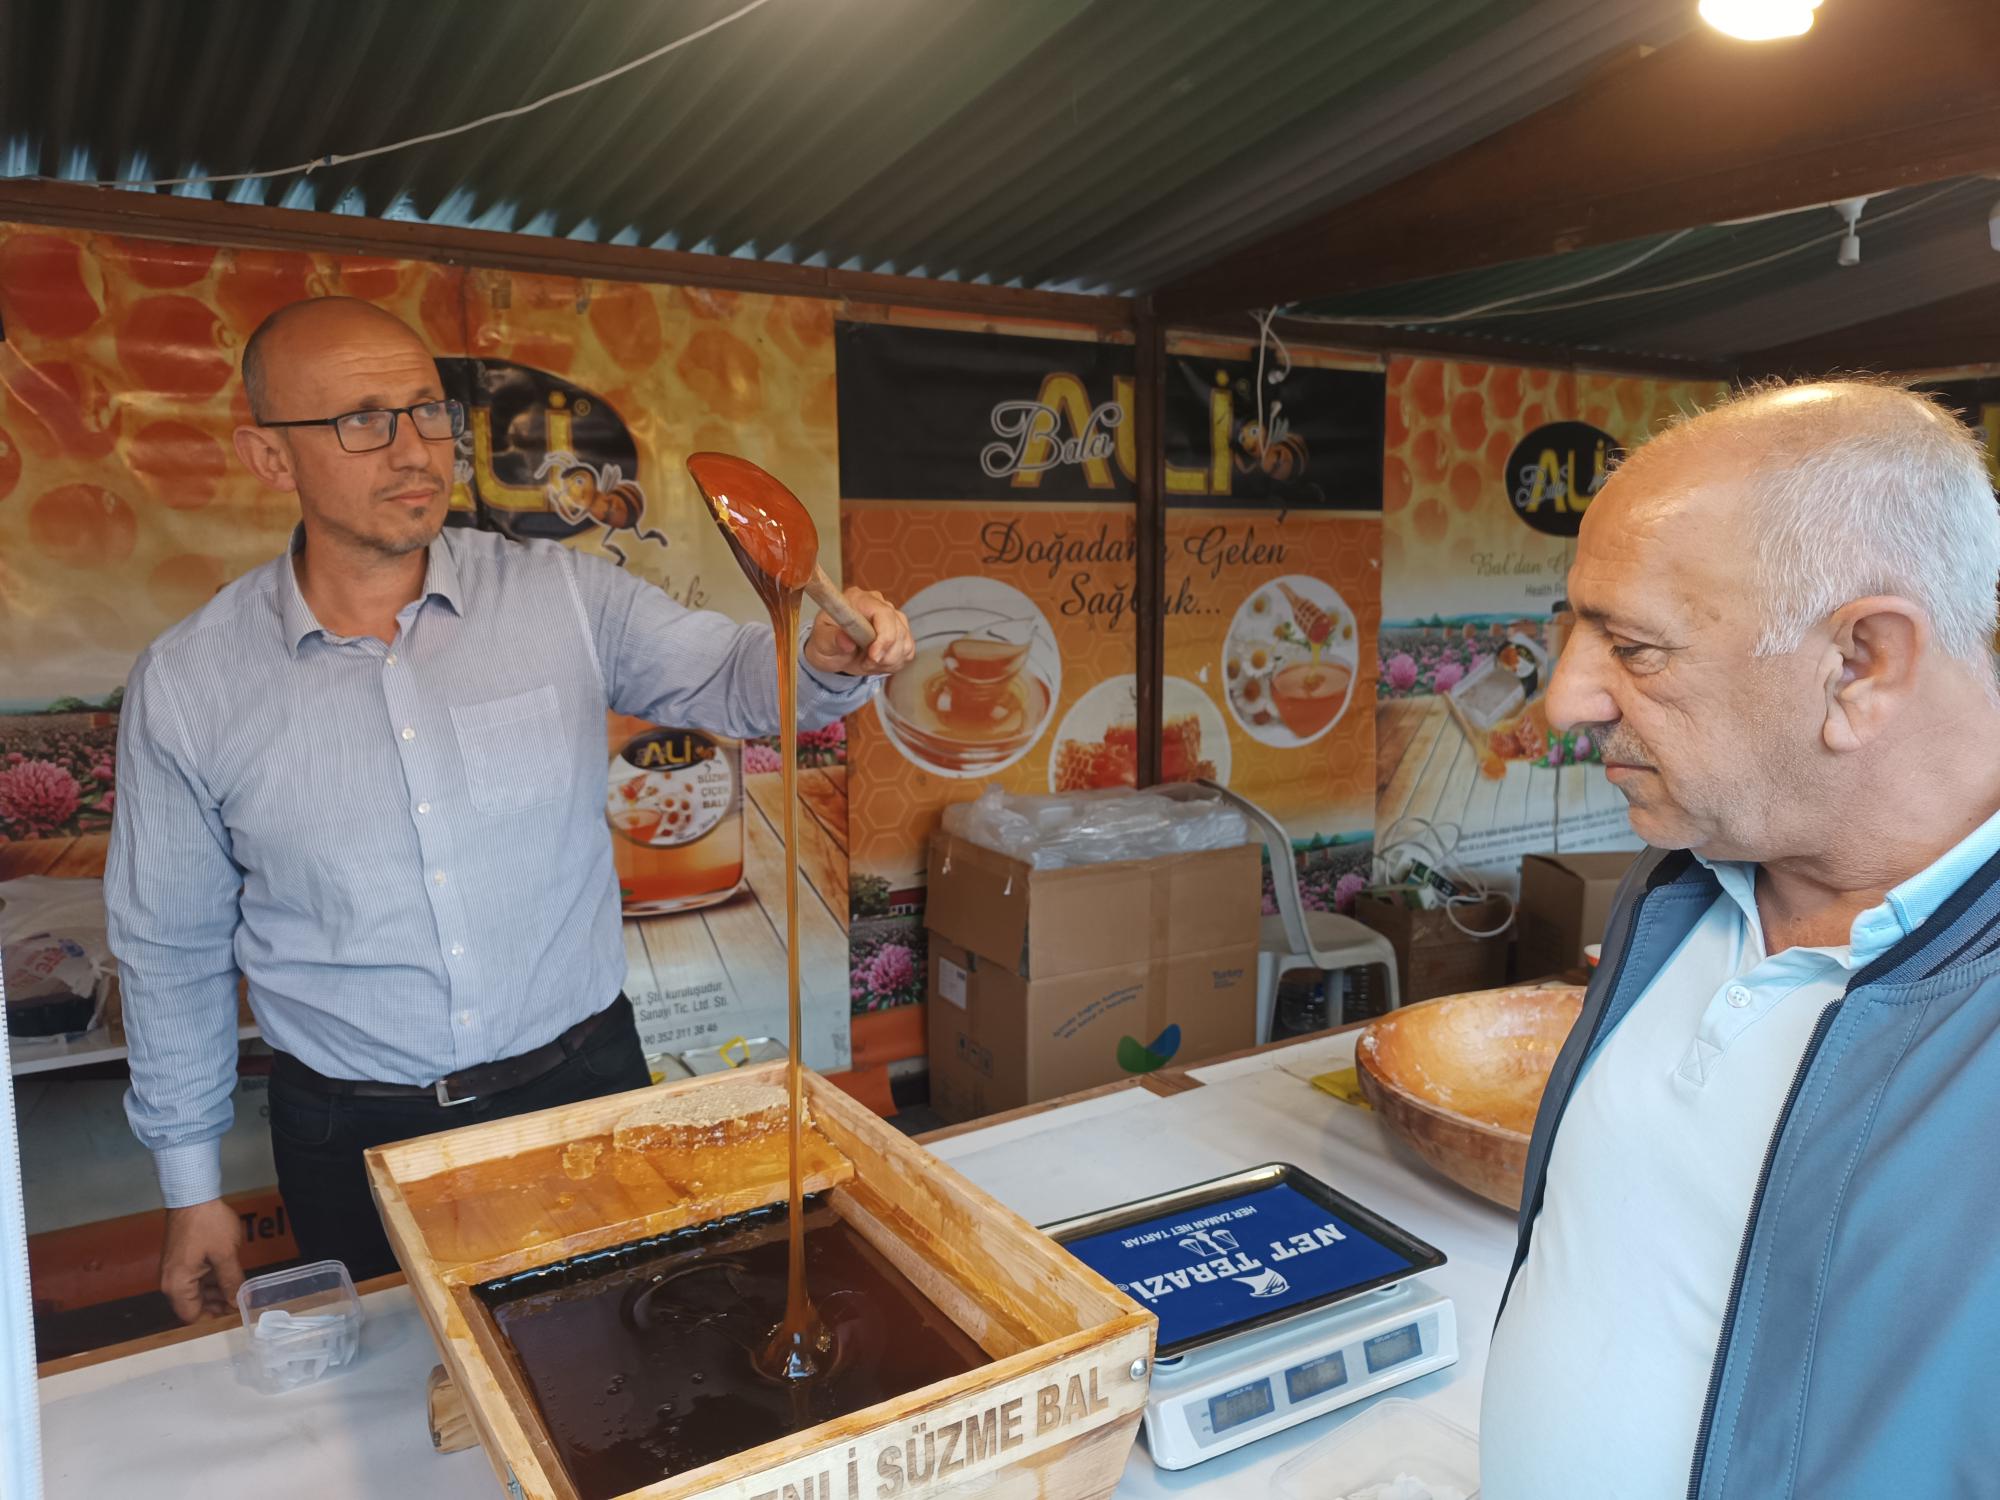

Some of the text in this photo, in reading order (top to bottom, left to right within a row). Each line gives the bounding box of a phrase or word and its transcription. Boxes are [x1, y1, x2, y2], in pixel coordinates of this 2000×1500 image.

[1184, 525, 1288, 579] Gelen
[1121, 1205, 1257, 1248] HER ZAMAN NET TARTAR
[1129, 1223, 1347, 1304] NET TERAZİ
[876, 1397, 1023, 1499] SÜZME
[1036, 1367, 1109, 1437] BAL
